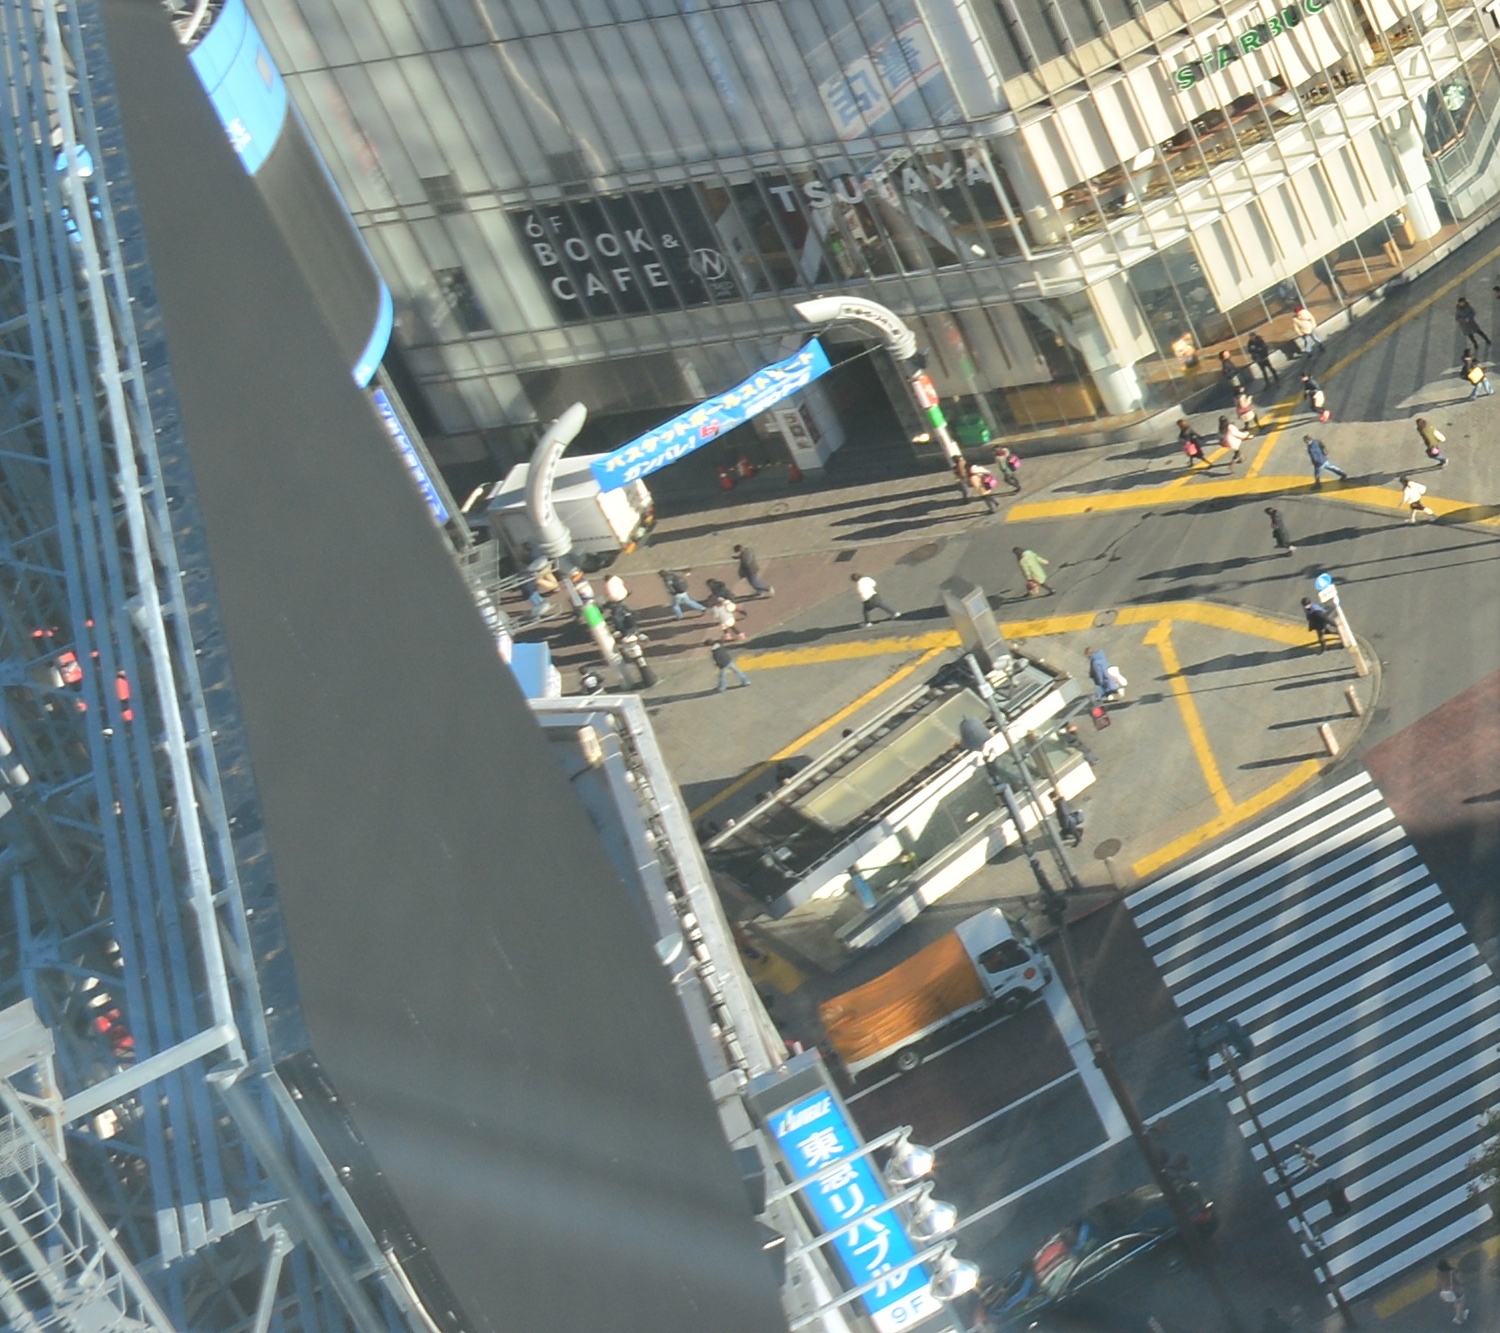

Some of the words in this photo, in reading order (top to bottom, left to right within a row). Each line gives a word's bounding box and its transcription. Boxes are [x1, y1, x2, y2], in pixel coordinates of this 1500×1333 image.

[530, 228, 654, 267] BOOK
[551, 262, 669, 301] CAFE
[797, 1125, 909, 1299] 東急リバブル
[889, 1294, 926, 1327] 9F
